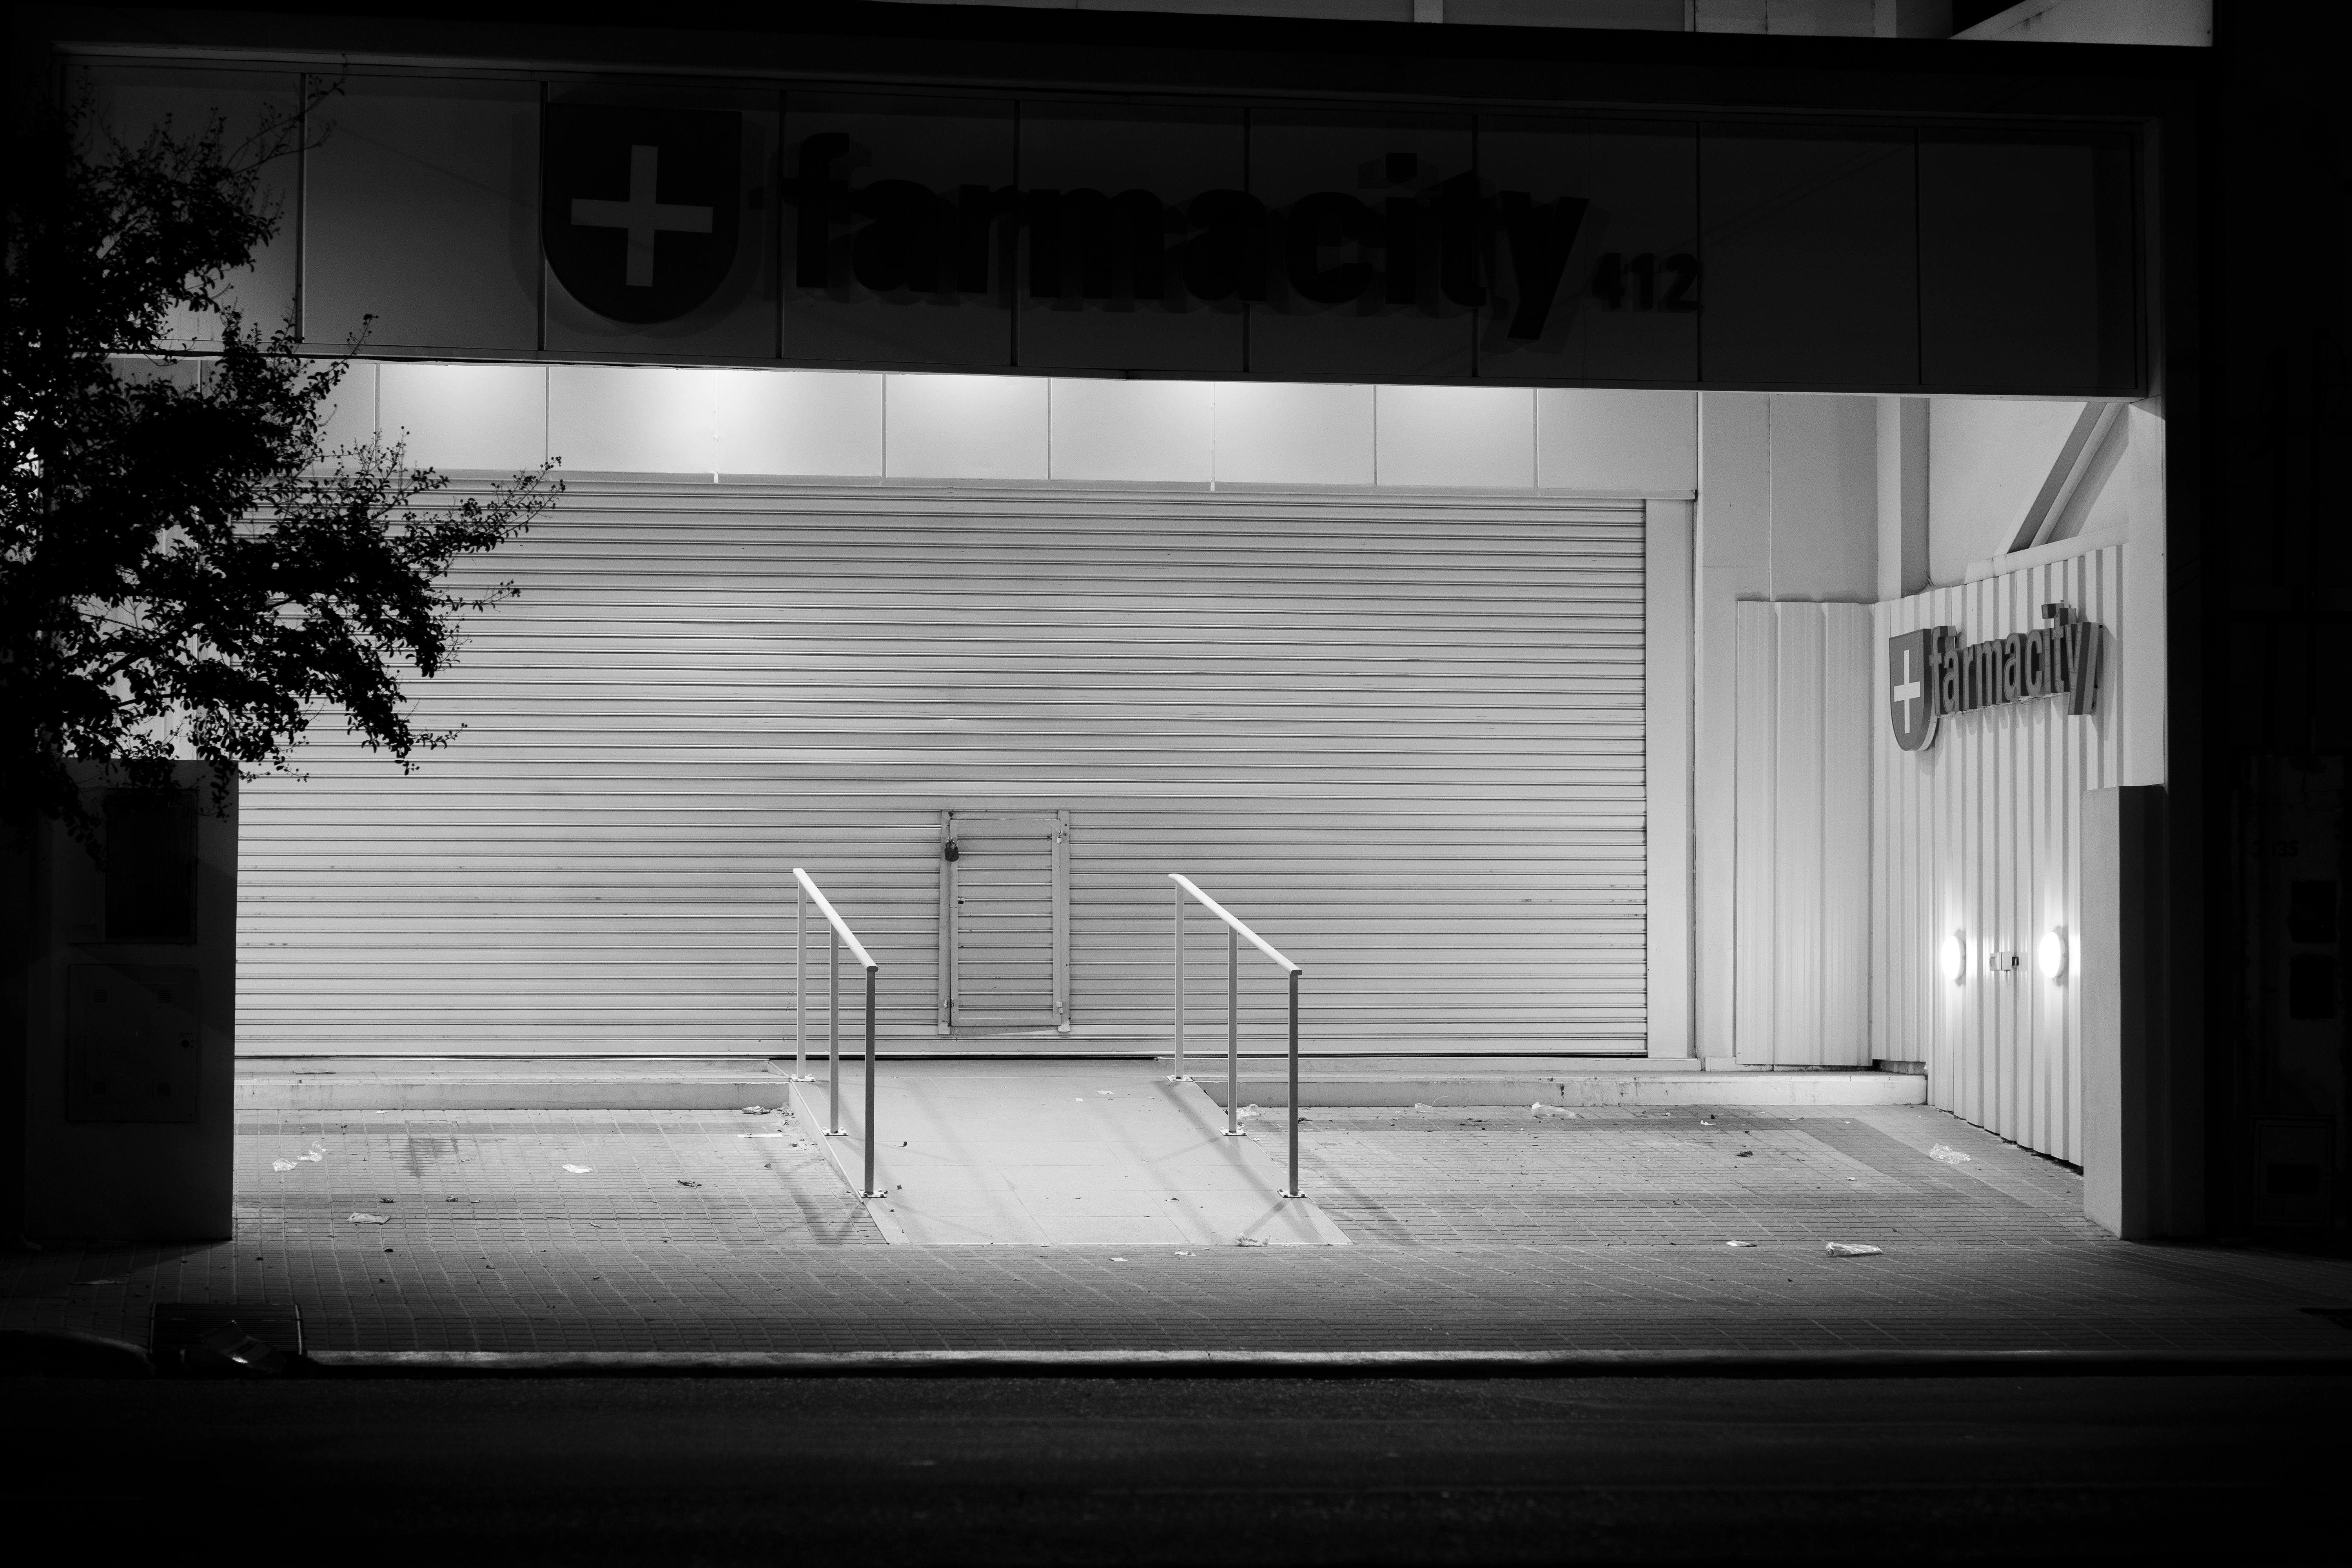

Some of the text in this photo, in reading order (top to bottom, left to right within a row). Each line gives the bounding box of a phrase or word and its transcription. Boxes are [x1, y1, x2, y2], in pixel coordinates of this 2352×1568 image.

[780, 132, 1701, 341] farmacity 412
[1929, 603, 2100, 715] farmacity
